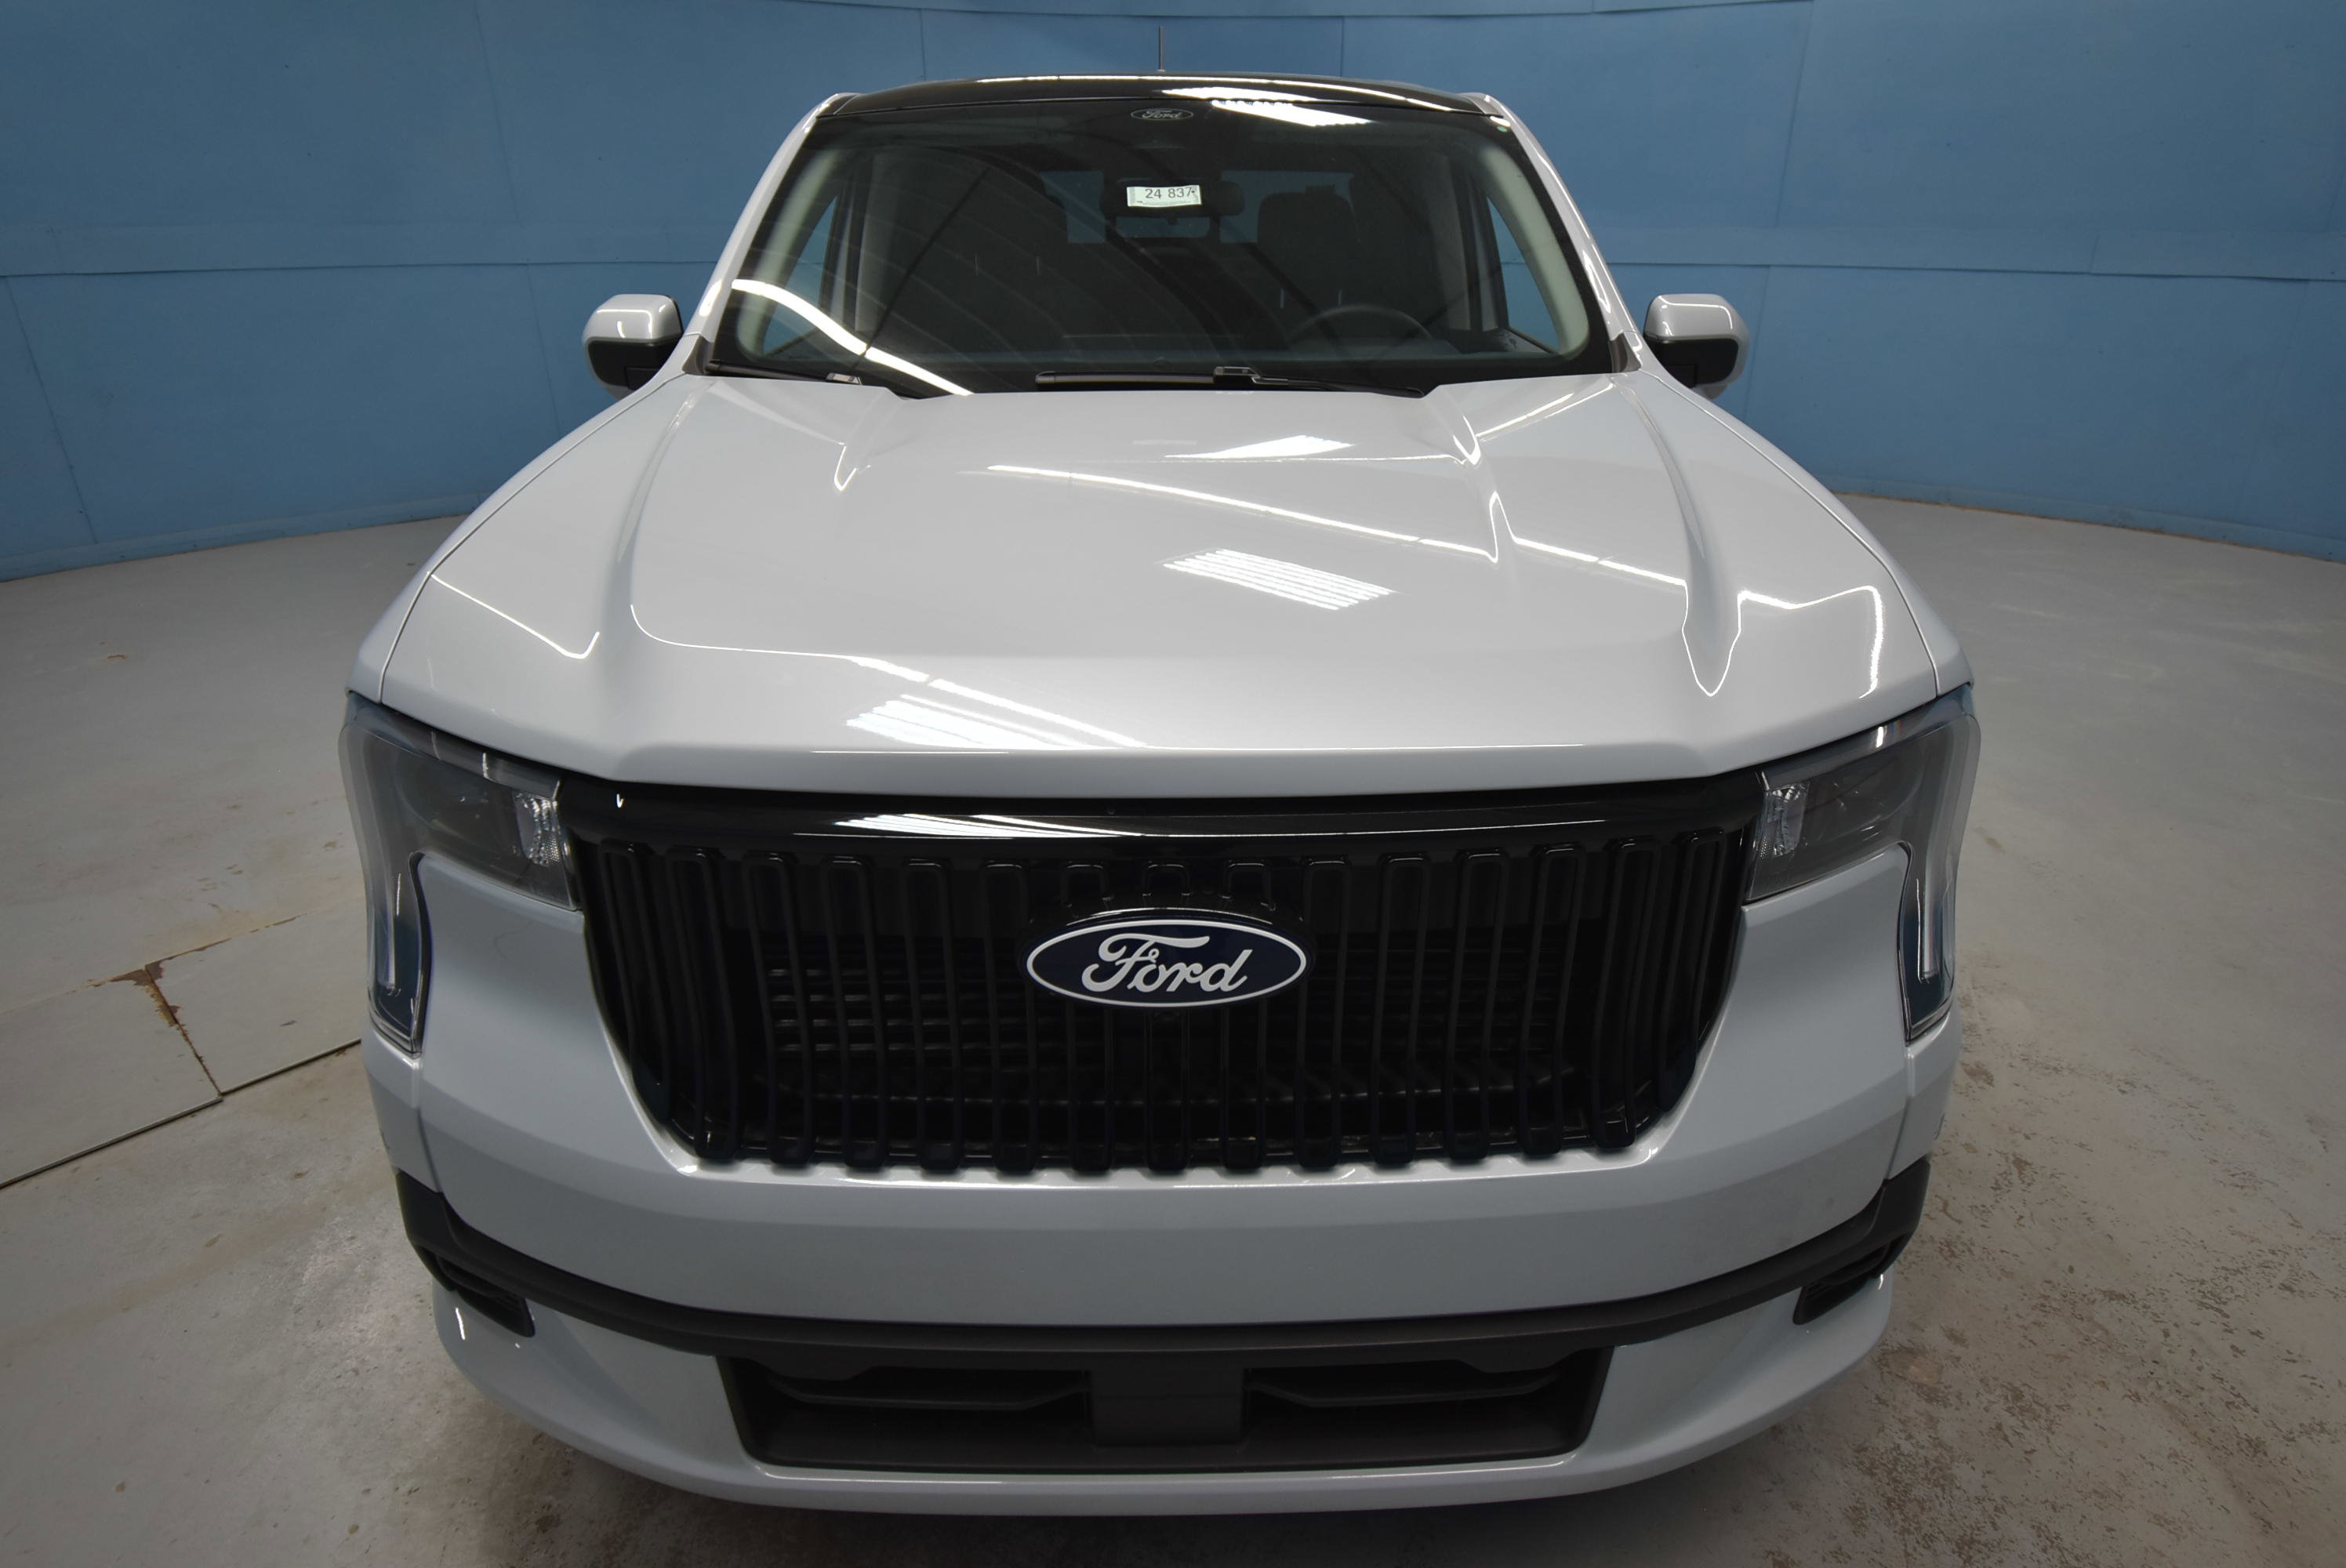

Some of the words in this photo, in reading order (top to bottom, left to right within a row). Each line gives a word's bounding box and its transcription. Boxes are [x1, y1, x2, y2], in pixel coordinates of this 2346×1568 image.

[1142, 110, 1182, 118] Ford
[1145, 188, 1162, 198] 24
[1168, 187, 1193, 198] 837
[1081, 933, 1253, 993] Ford
